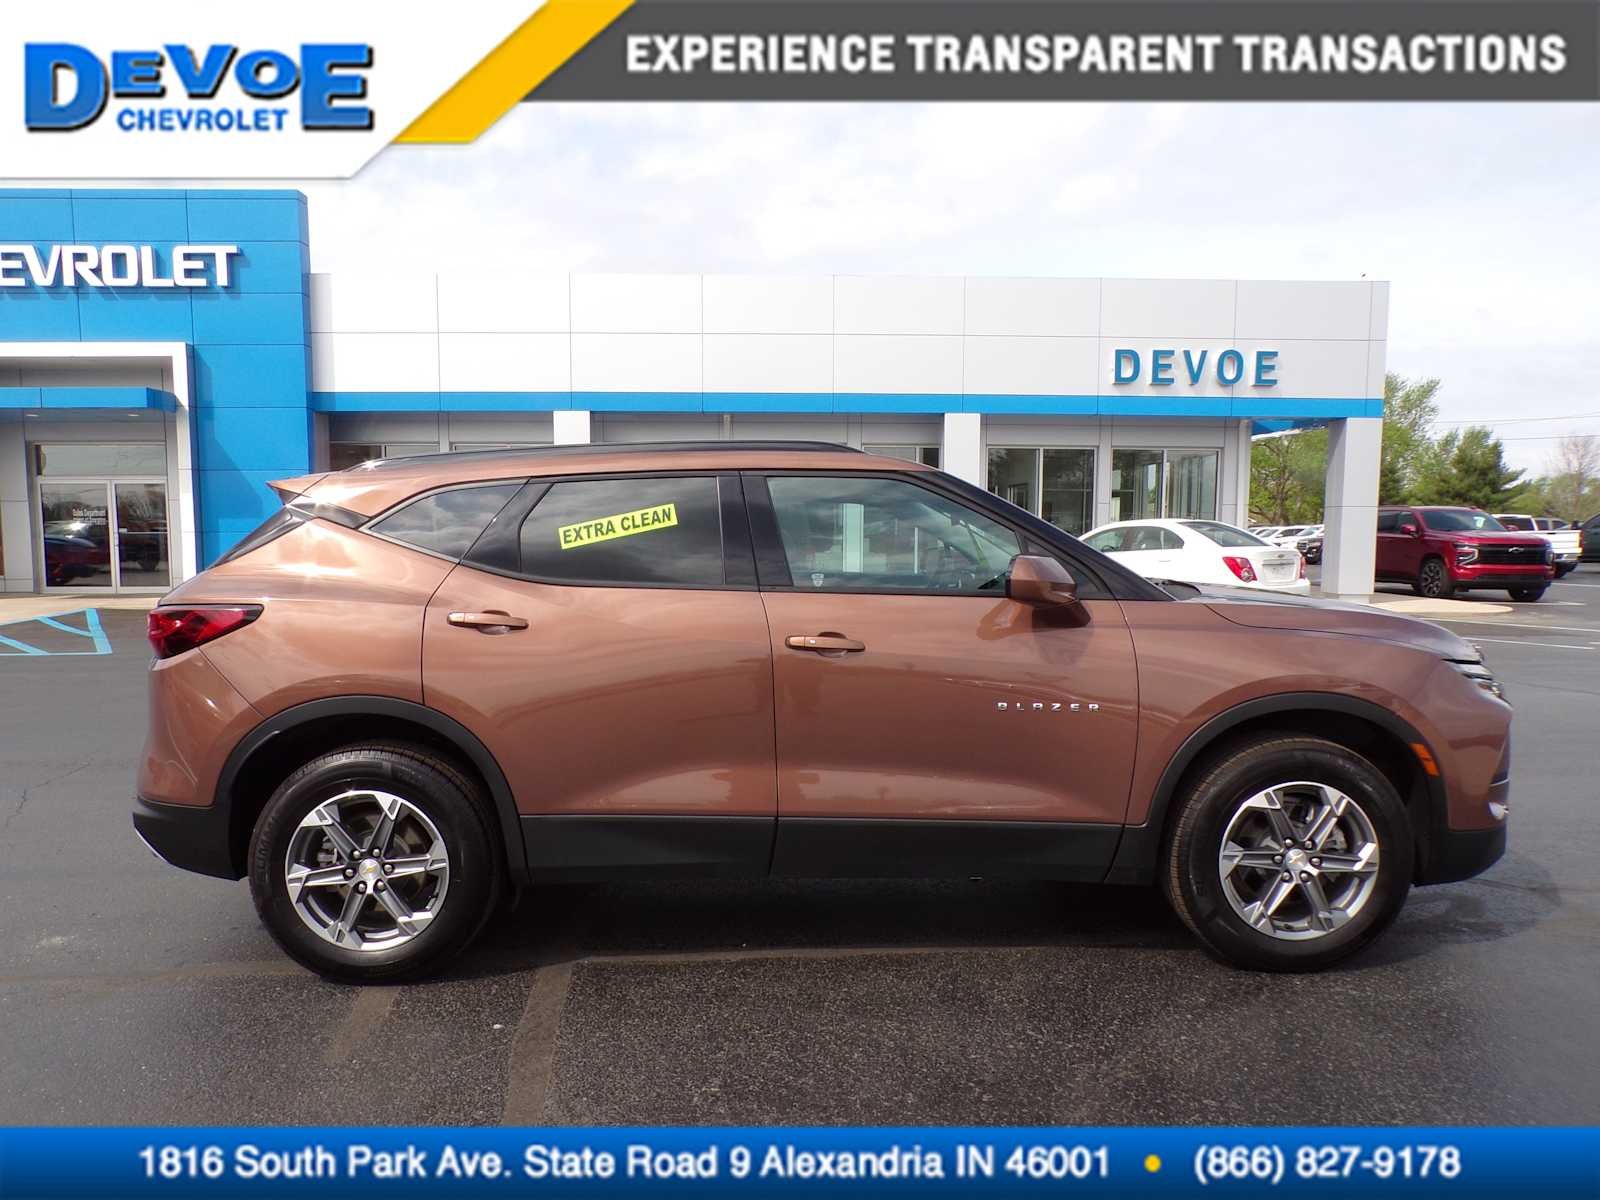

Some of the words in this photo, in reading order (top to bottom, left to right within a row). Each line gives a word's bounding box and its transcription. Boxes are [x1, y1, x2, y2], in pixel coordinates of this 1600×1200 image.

[1113, 348, 1279, 387] DEVOE
[563, 520, 616, 545] EXTRA
[620, 507, 672, 531] CLEAN
[997, 702, 1100, 712] BLAZER
